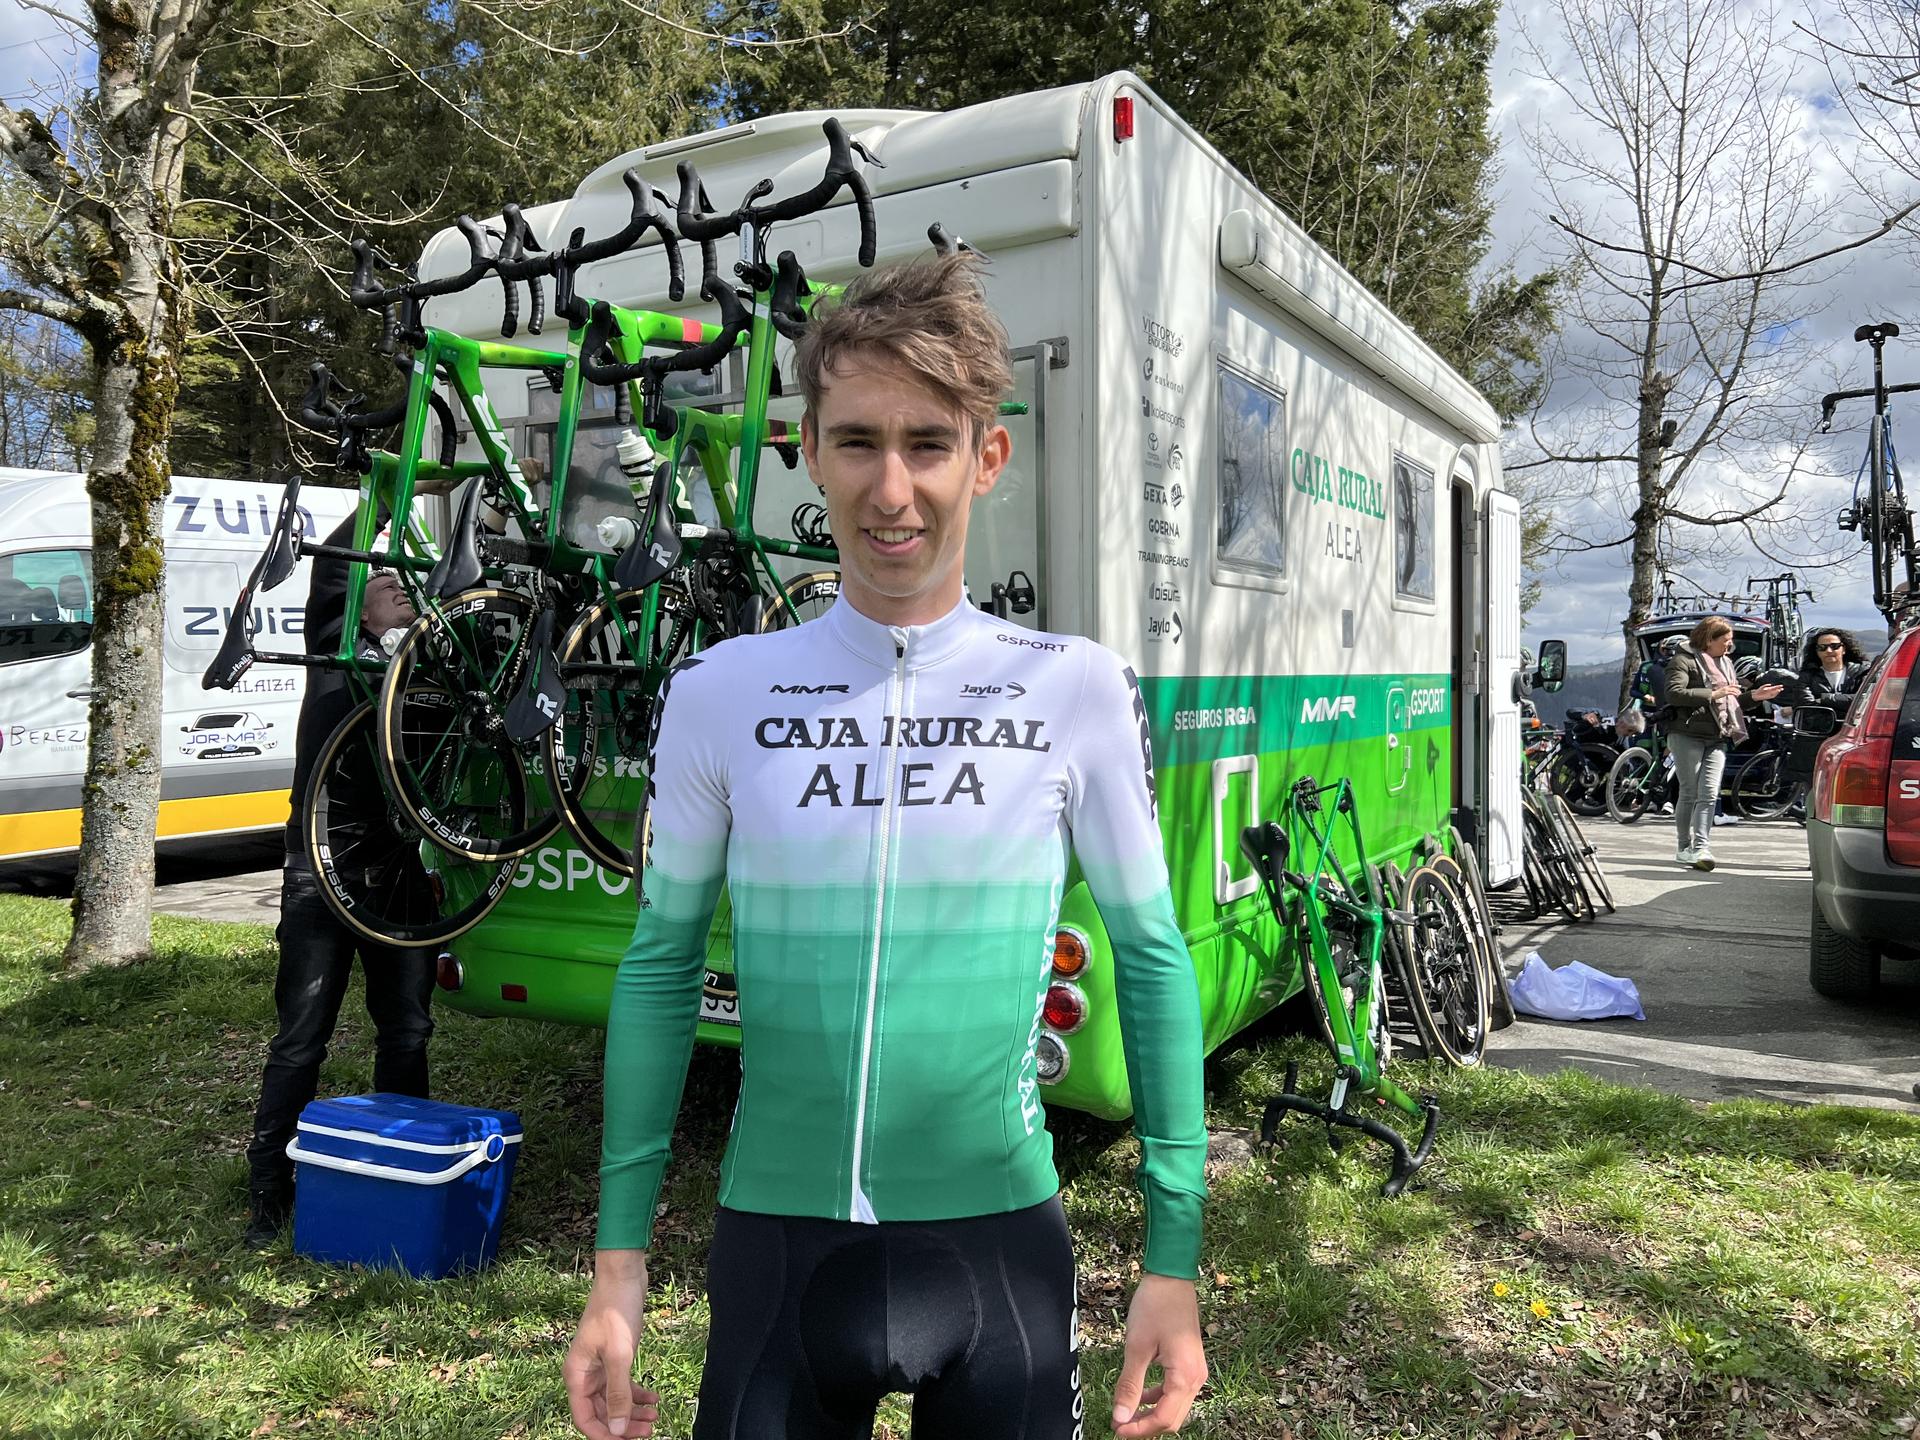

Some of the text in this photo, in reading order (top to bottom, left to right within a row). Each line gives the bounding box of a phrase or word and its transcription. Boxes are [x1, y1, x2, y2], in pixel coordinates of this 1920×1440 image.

[1142, 316, 1176, 344] VICTORY
[1148, 335, 1180, 358] ENDURANCE
[1144, 482, 1169, 506] GEXA
[1291, 448, 1386, 521] CAJA RURAL
[1148, 518, 1180, 538] GOERNA
[1325, 521, 1363, 565] ALEA
[1138, 550, 1189, 568] TRAININGPEAKS
[1148, 616, 1171, 637] Jaylo
[996, 634, 1069, 652] GSPORT
[770, 684, 850, 695] MMR
[960, 684, 1002, 696] Jaylo
[1410, 688, 1446, 716] GSPORT
[1174, 706, 1257, 731] SEGUROS RGA
[1301, 695, 1356, 723] MMR
[755, 716, 1052, 752] CAJA RURAL
[797, 763, 986, 807] ALEA
[418, 806, 473, 850] URSUS
[319, 844, 356, 909] URSUS
